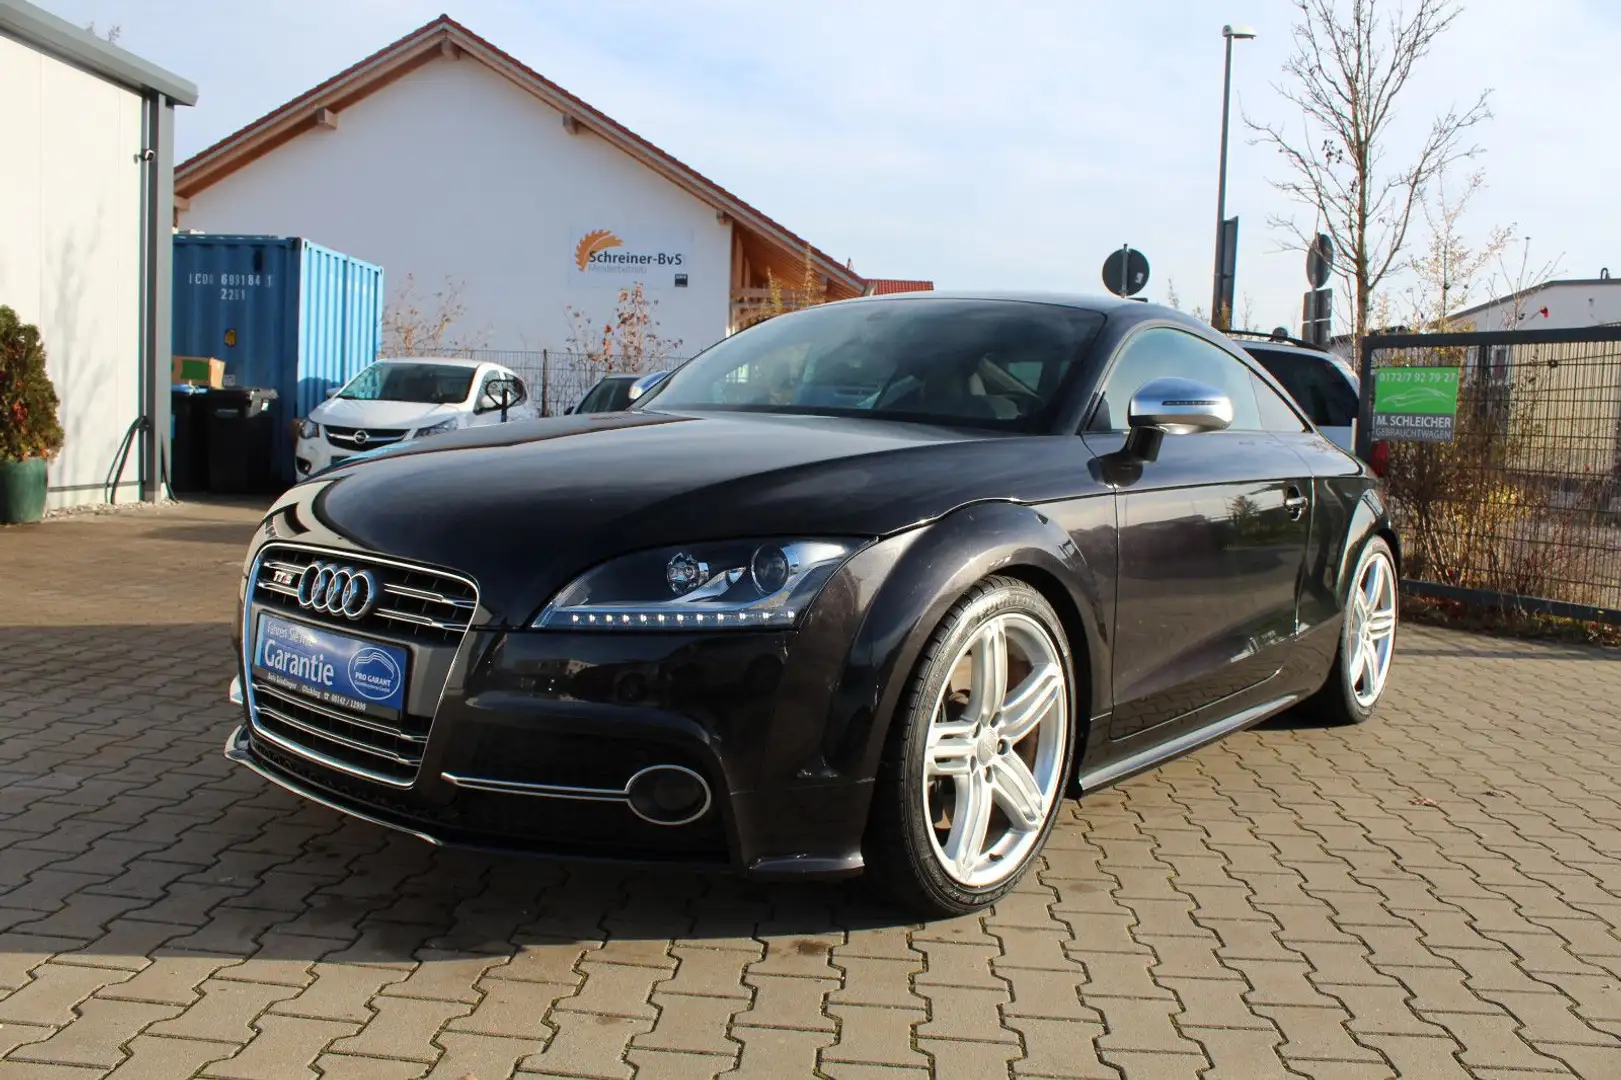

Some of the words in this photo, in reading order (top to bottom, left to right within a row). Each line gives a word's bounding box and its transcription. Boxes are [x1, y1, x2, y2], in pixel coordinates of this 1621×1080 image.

[589, 251, 682, 265] Schreiner-BvS
[1414, 372, 1426, 383] 92
[1376, 415, 1388, 426] M.
[1390, 415, 1451, 429] SCHLEICHER
[264, 639, 335, 686] Garantie
[354, 671, 367, 681] PRO
[367, 674, 392, 687] GARANT
